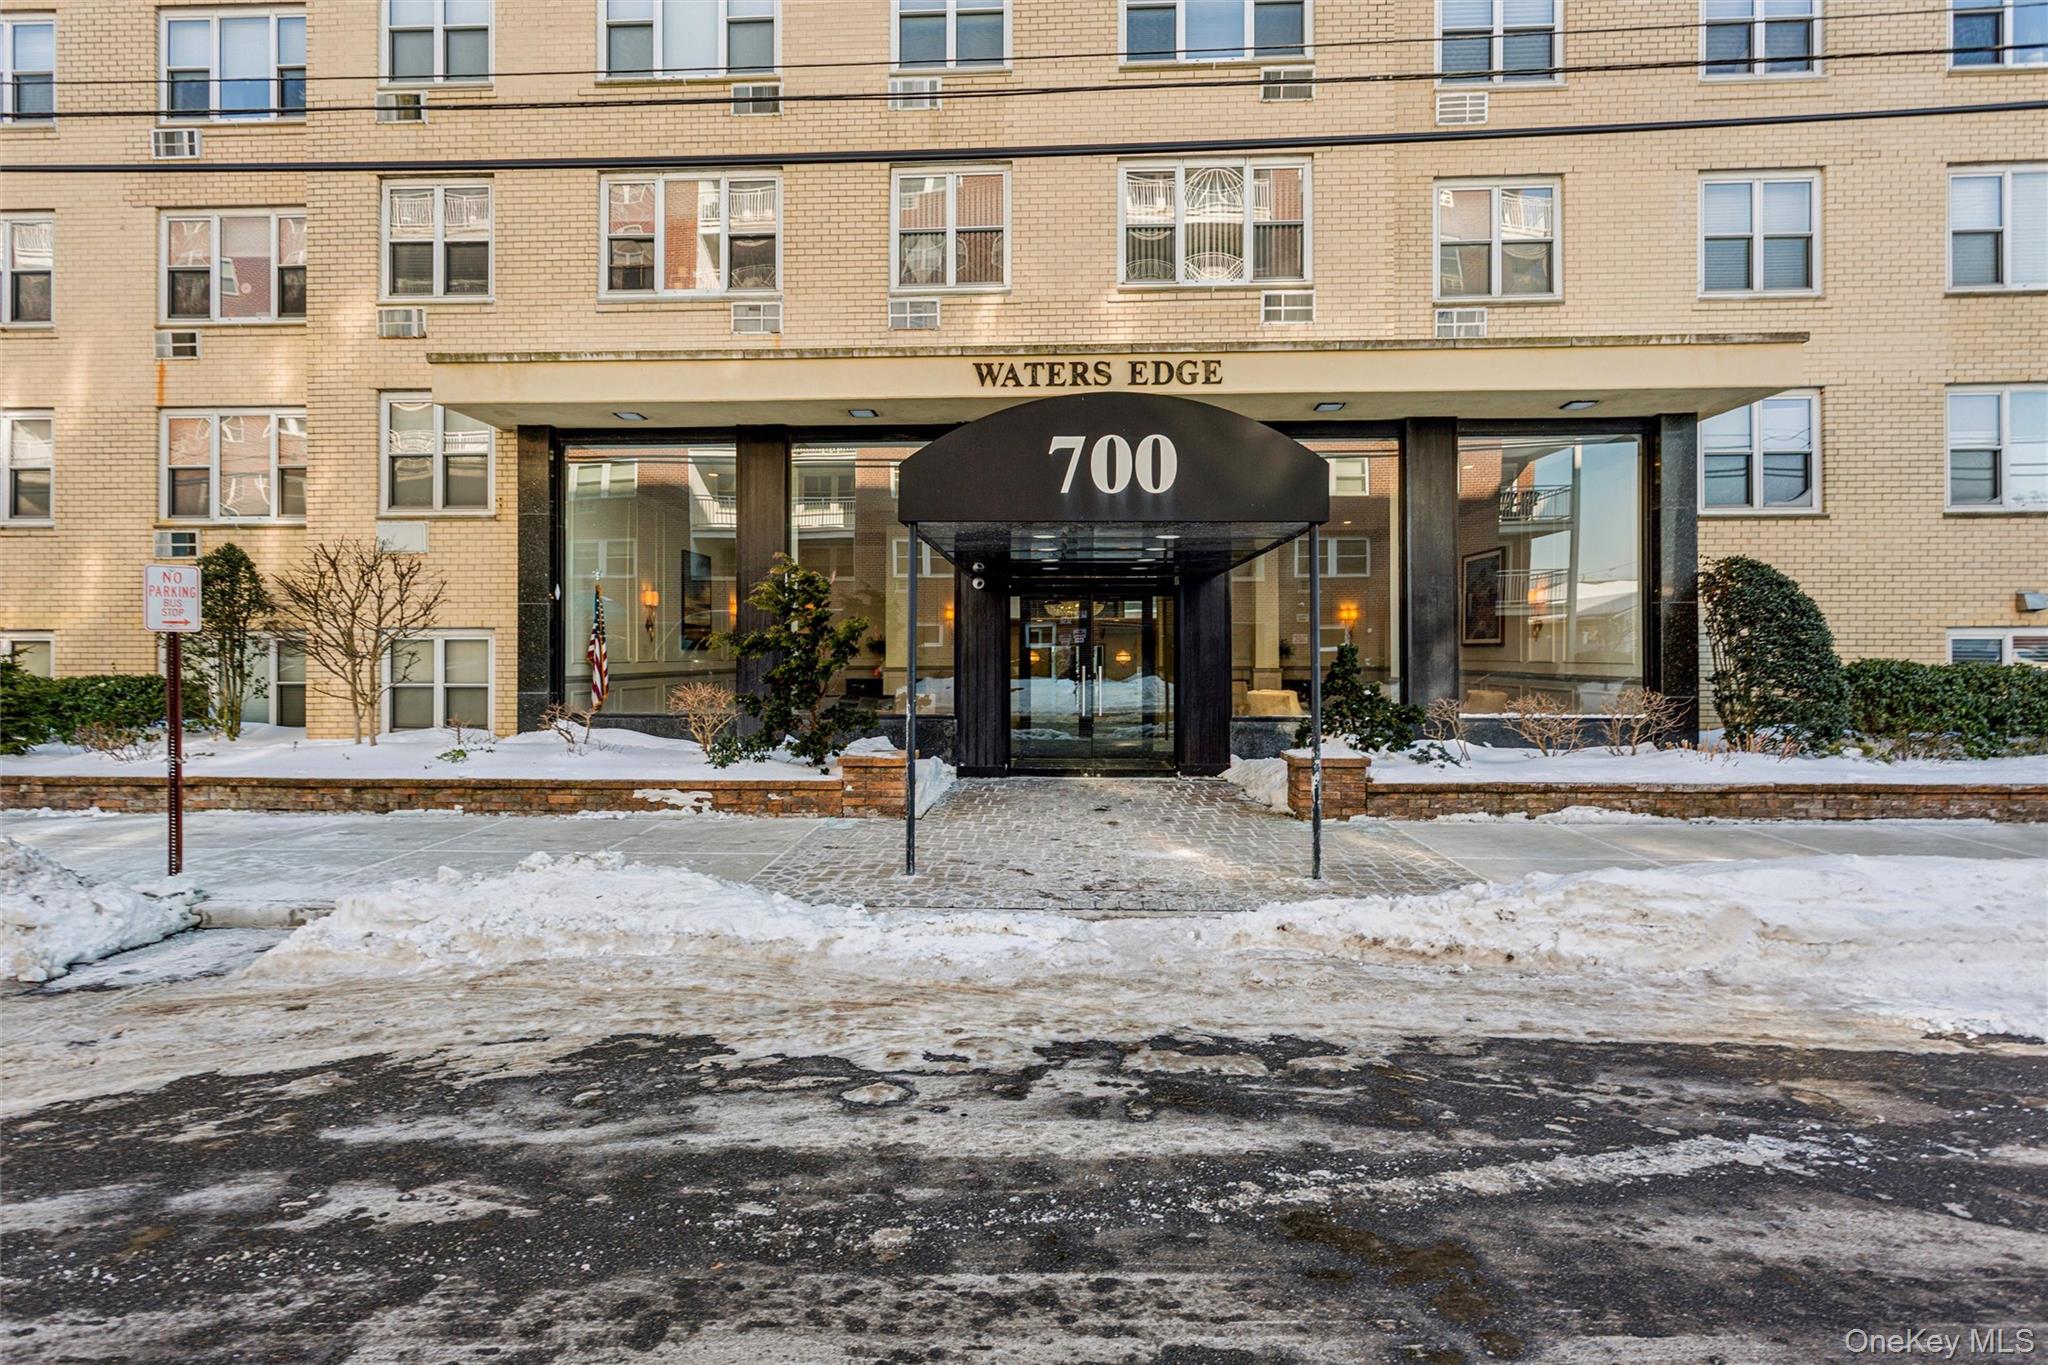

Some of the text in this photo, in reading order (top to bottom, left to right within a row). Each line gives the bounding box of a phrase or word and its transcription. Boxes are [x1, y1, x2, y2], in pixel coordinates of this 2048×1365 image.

[972, 359, 1223, 388] WATERS EDGE
[1048, 434, 1178, 495] 700
[162, 571, 182, 584] NO
[149, 585, 197, 598] PARKING
[163, 599, 182, 607] BUS
[161, 608, 184, 617] STOP
